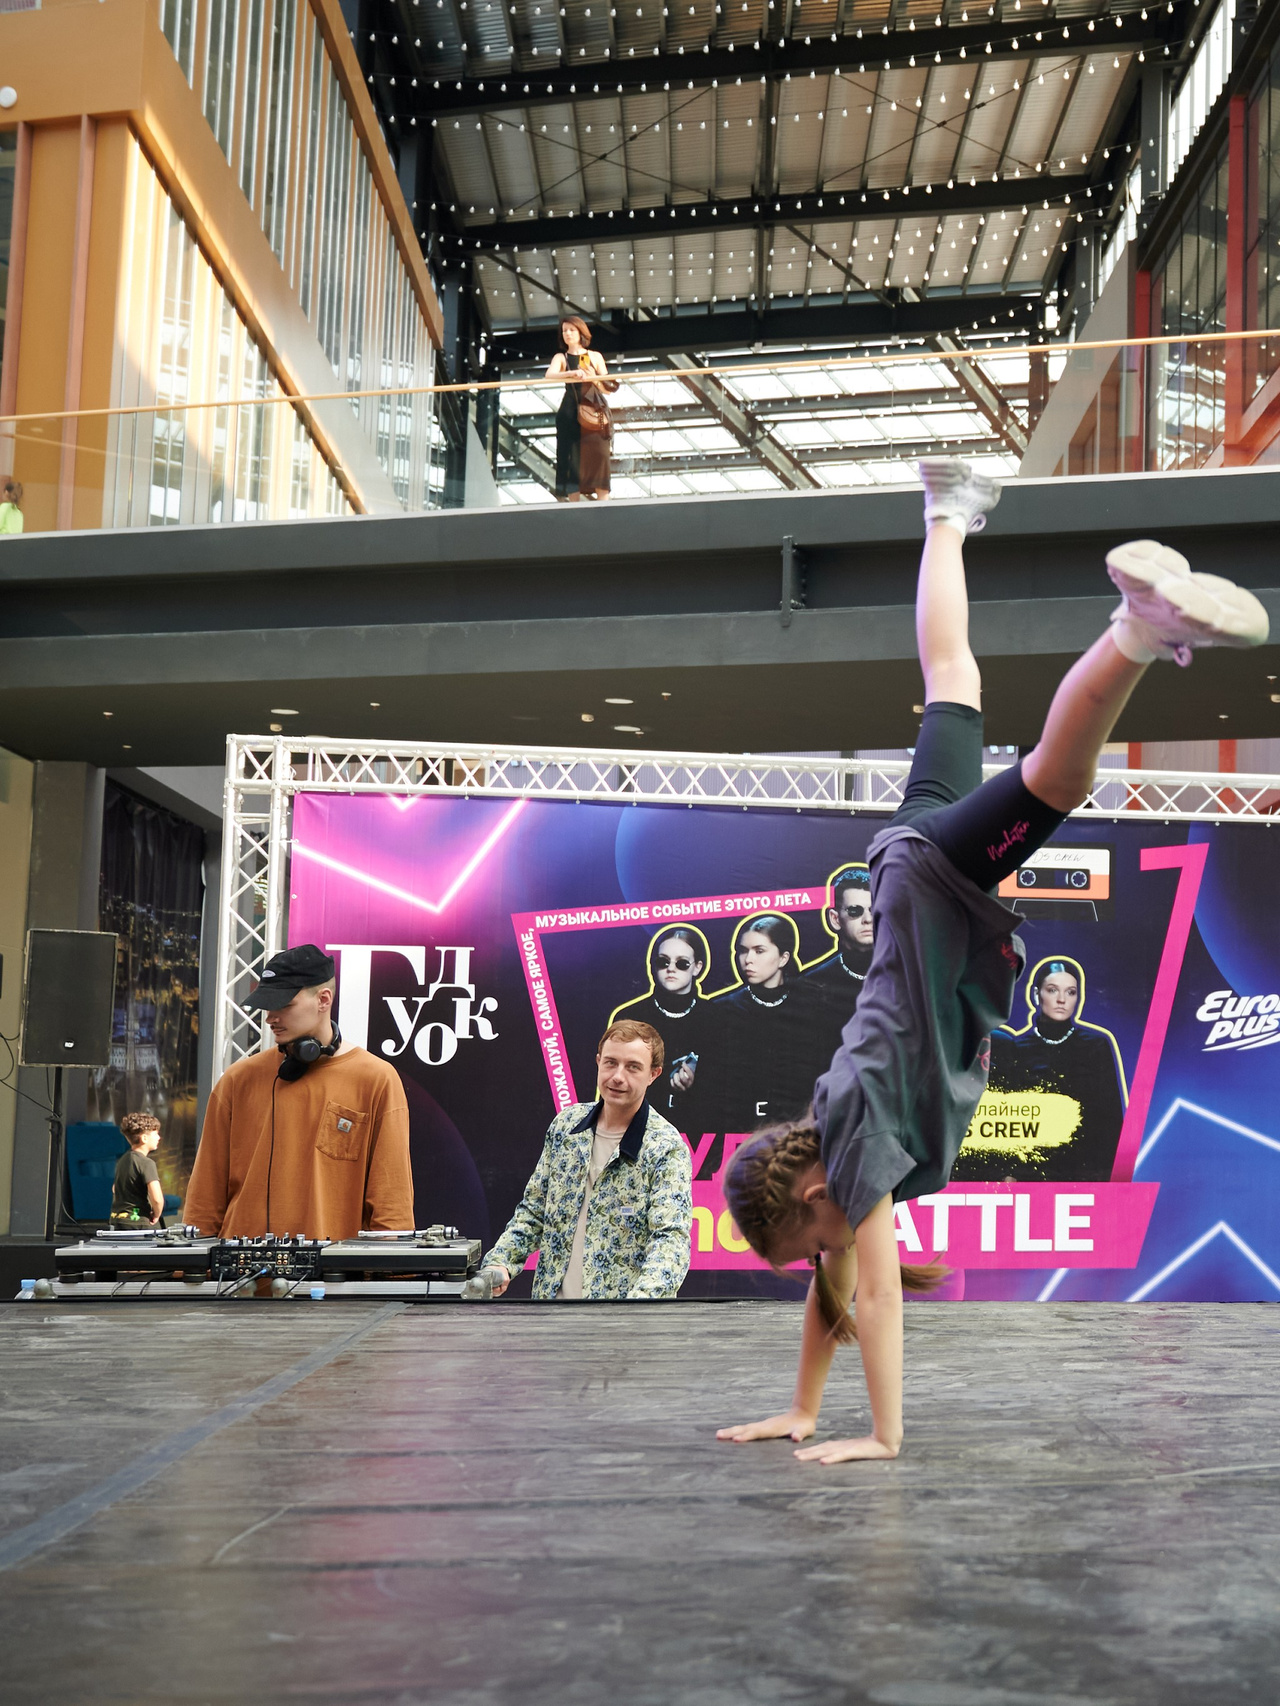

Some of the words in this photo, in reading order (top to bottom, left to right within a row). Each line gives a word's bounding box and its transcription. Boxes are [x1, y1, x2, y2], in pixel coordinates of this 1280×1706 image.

[535, 909, 650, 928] МУЗЫКАЛЬНОЕ
[655, 899, 722, 918] СОБЫТИЕ
[725, 895, 771, 911] ЭТОГО
[774, 892, 812, 909] ЛЕТА
[521, 928, 541, 978] ЯРКОЕ,
[532, 979, 554, 1031] САМОЕ
[543, 1032, 572, 1112] ПОЖАЛУЙ,
[973, 1101, 1041, 1120] лайнер
[980, 1121, 1040, 1138] CREW
[892, 1193, 1095, 1252] ATTLE
